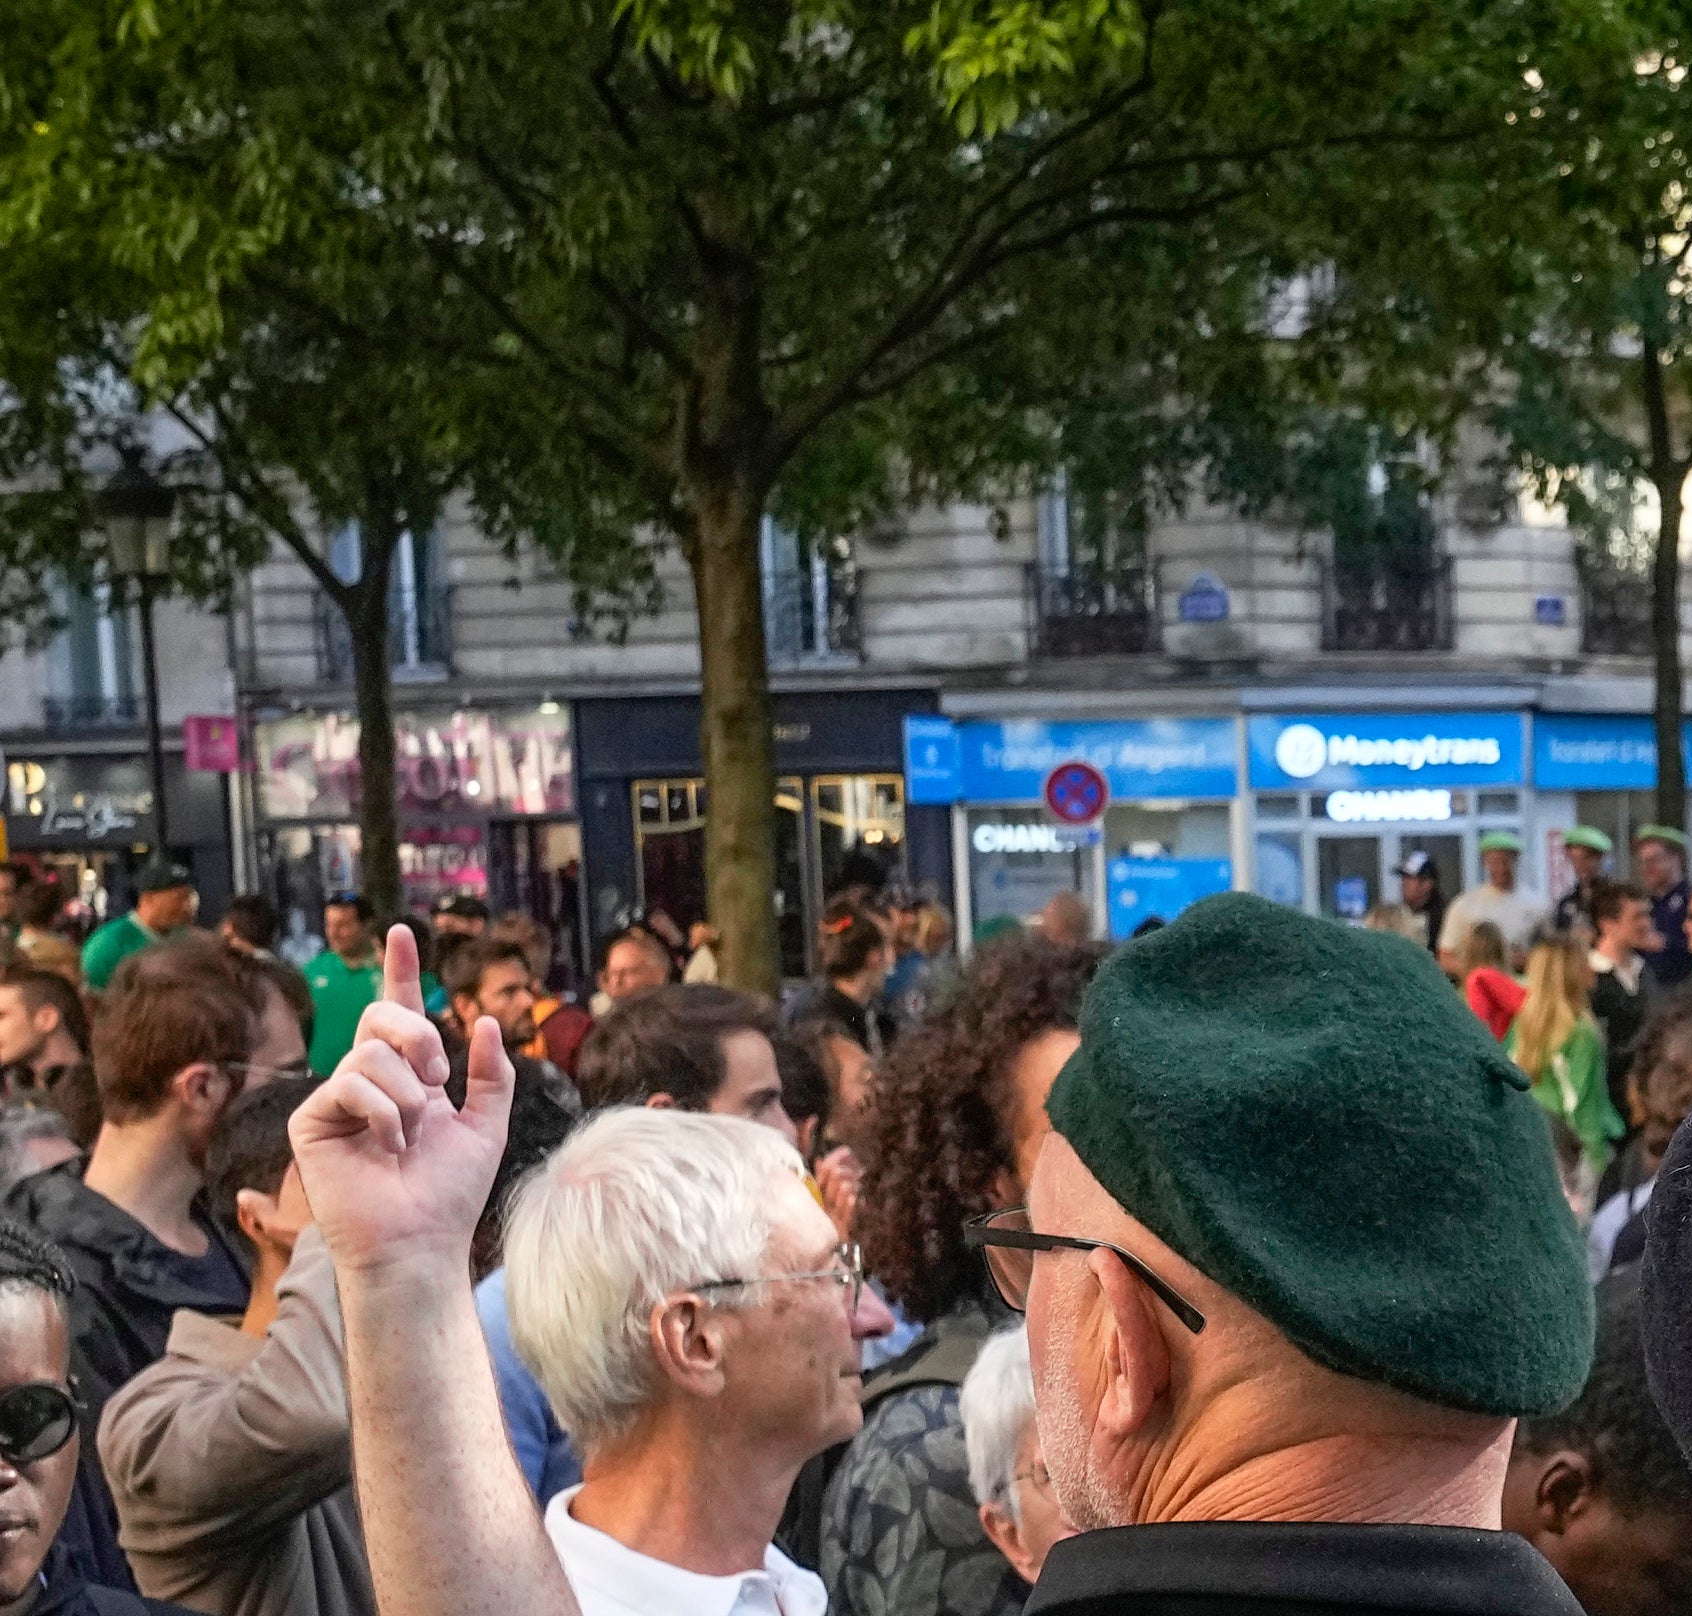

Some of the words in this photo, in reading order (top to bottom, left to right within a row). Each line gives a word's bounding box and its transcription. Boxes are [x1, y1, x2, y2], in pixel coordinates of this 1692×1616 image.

[1328, 734, 1500, 771] Moneytrans
[1326, 788, 1452, 822] CHANGE
[973, 823, 1078, 853] CHAN
